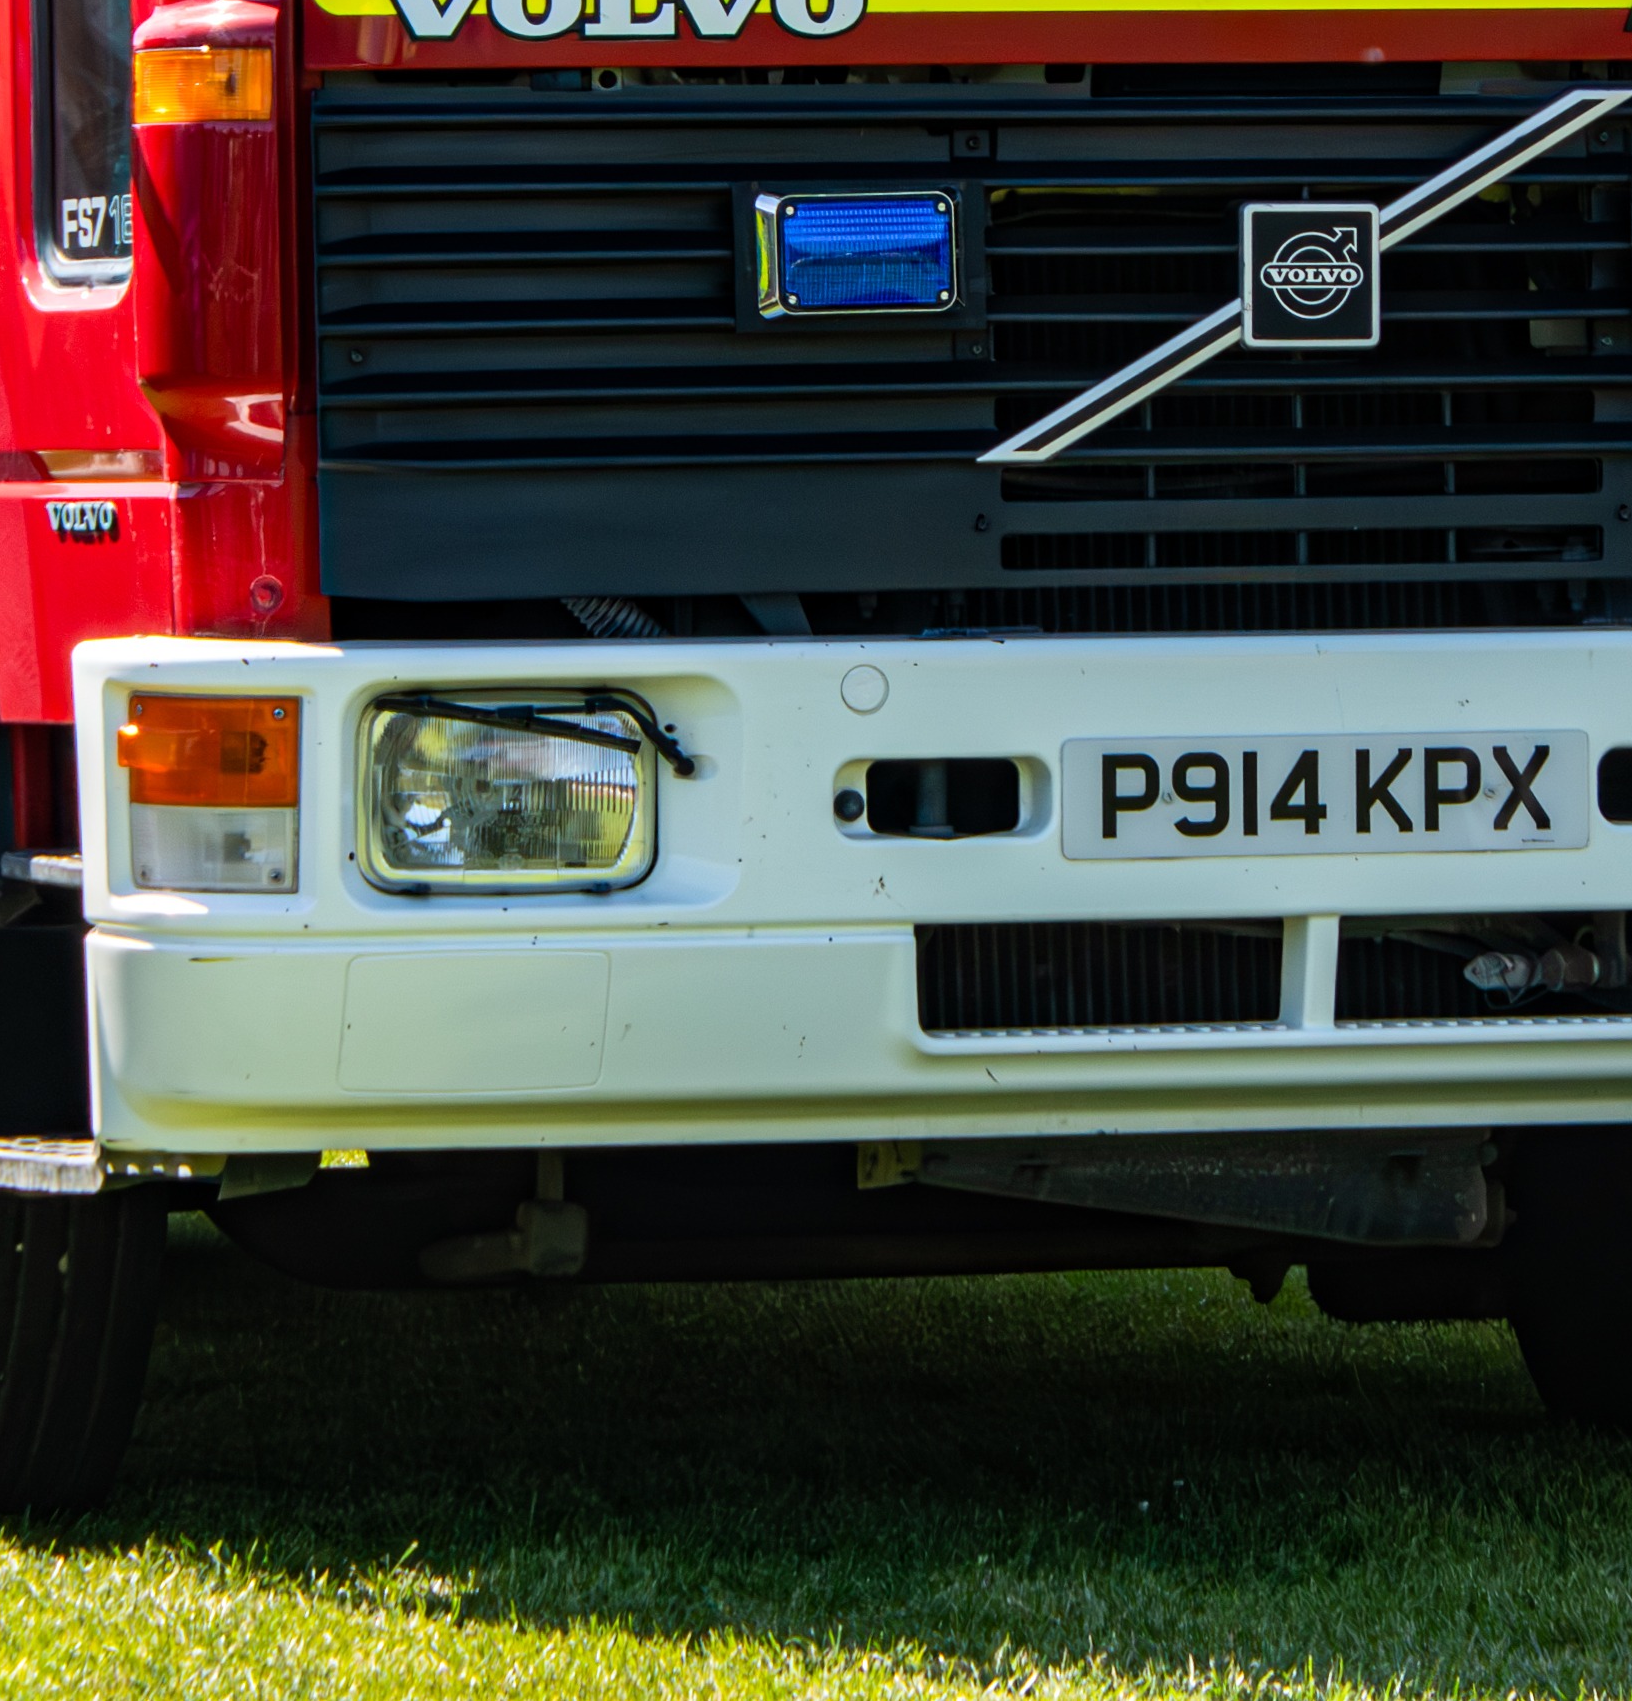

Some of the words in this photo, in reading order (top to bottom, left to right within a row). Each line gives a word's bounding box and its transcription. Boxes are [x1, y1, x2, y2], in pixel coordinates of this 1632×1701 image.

[62, 196, 107, 249] FS7
[1266, 267, 1358, 283] VOLVO
[45, 501, 115, 532] VOLVO
[1102, 749, 1327, 839] P914
[1355, 745, 1551, 834] KPX
